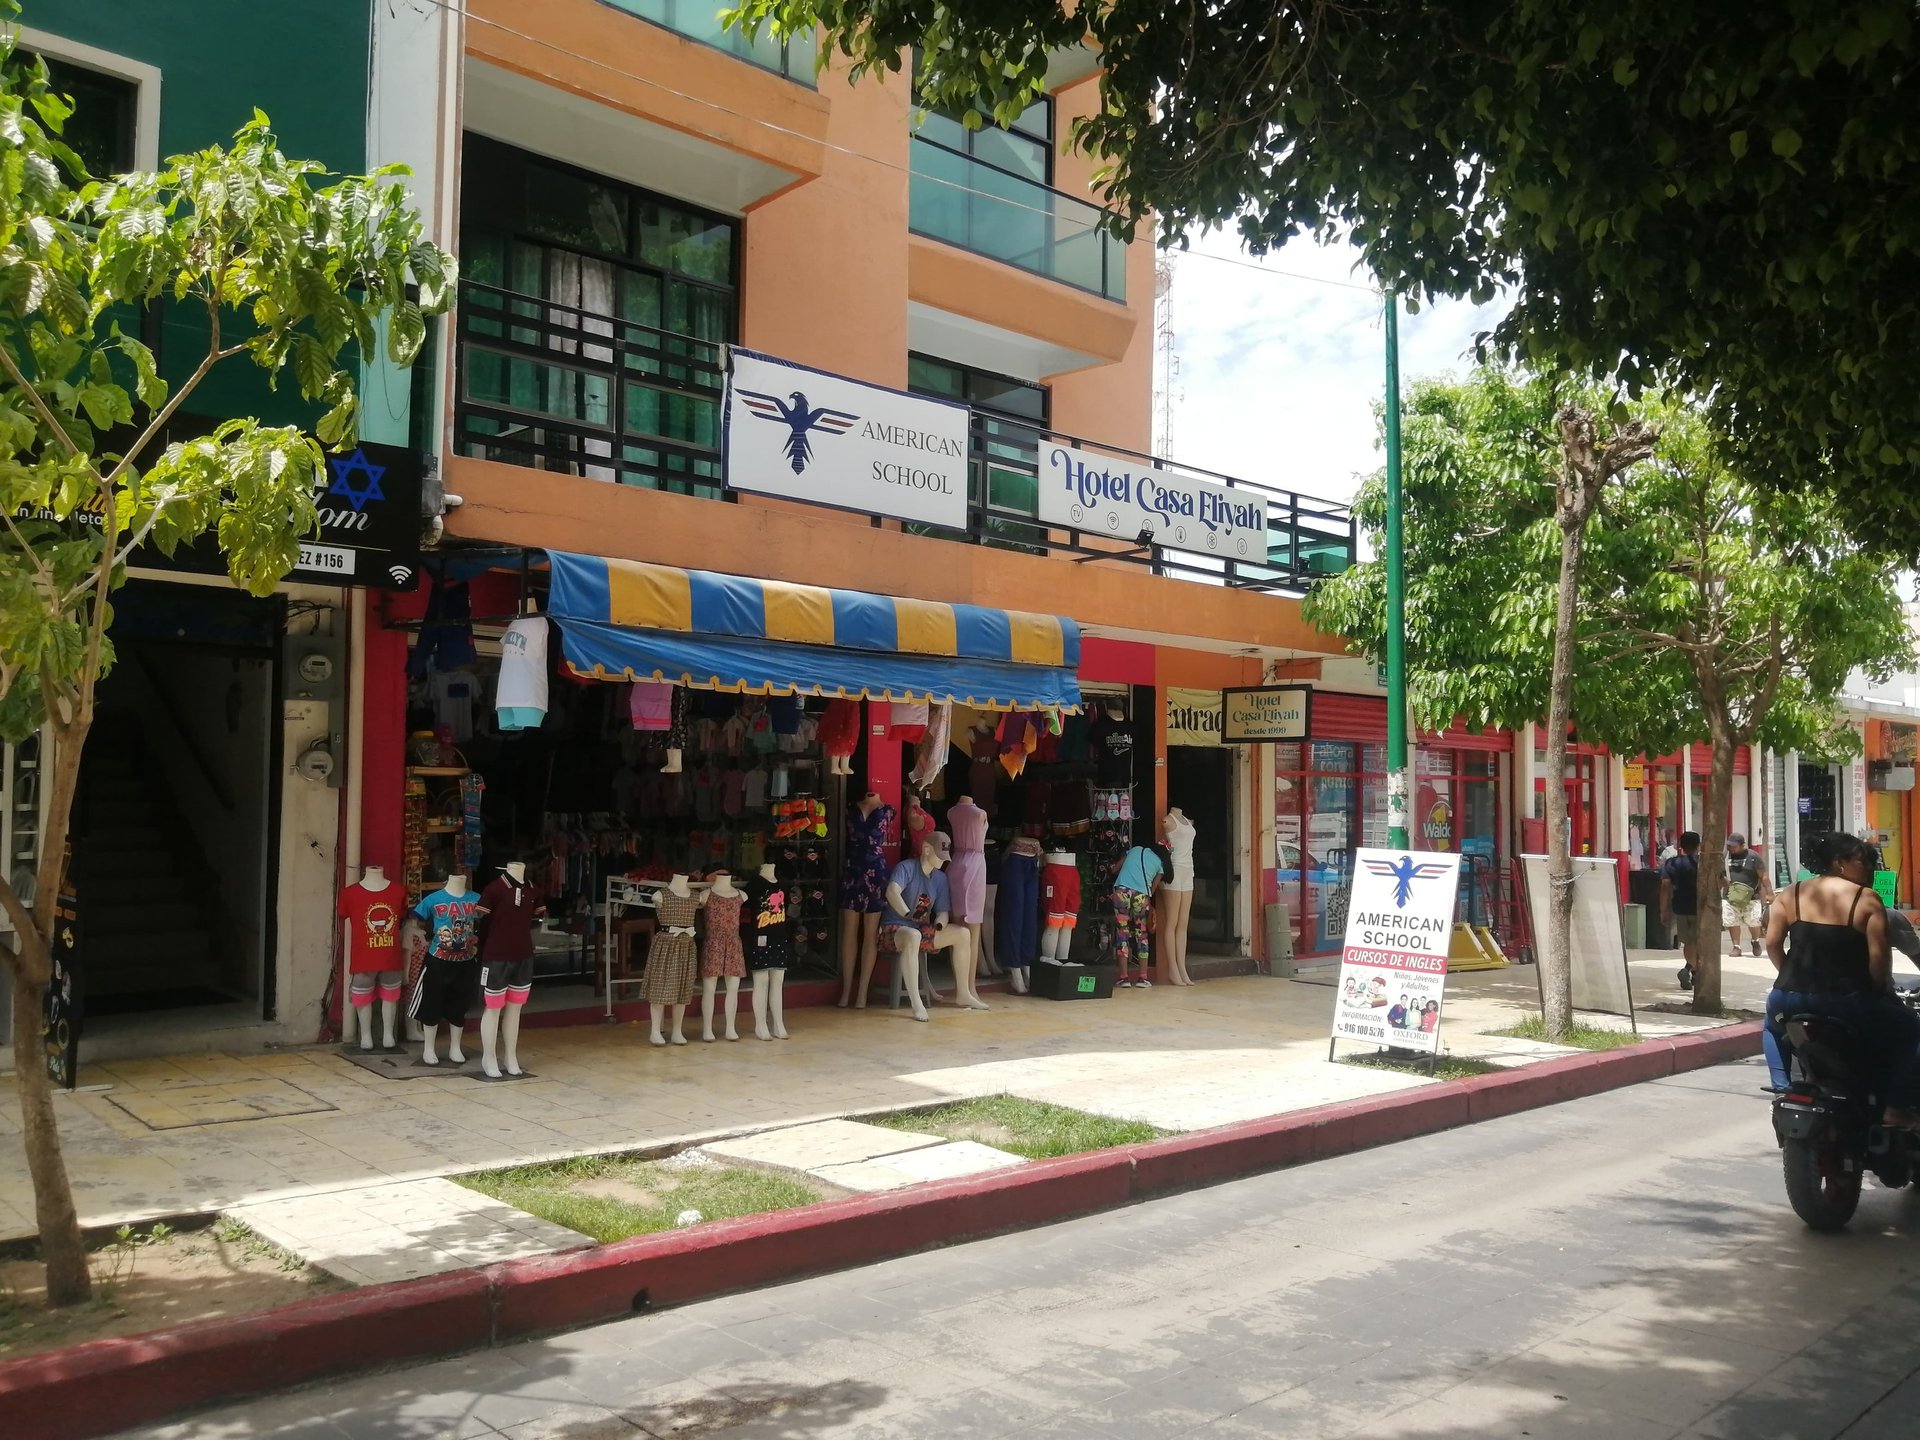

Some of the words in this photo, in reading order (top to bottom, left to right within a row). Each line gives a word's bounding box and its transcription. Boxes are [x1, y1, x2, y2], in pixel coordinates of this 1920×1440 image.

[861, 421, 964, 458] AMERICAN
[872, 460, 954, 495] SCHOOL
[1050, 448, 1131, 510] Hotel
[1136, 477, 1194, 527] Casa
[1198, 493, 1263, 536] Eliyah
[297, 550, 312, 566] EZ
[315, 552, 344, 569] #156
[1244, 693, 1281, 711] Hotel
[1232, 710, 1261, 726] Casa
[434, 902, 478, 919] PAW
[1356, 911, 1445, 933] AMERICAN
[369, 936, 394, 948] FLASH
[1362, 930, 1432, 951] SCHOOL
[1347, 949, 1388, 966] CURSOS
[1389, 953, 1404, 967] DE
[1405, 955, 1443, 972] INGLES
[1405, 981, 1430, 991] Adultos
[1343, 1022, 1356, 1034] 916
[1357, 1025, 1369, 1036] 100
[1393, 1029, 1429, 1041] OXFORD
